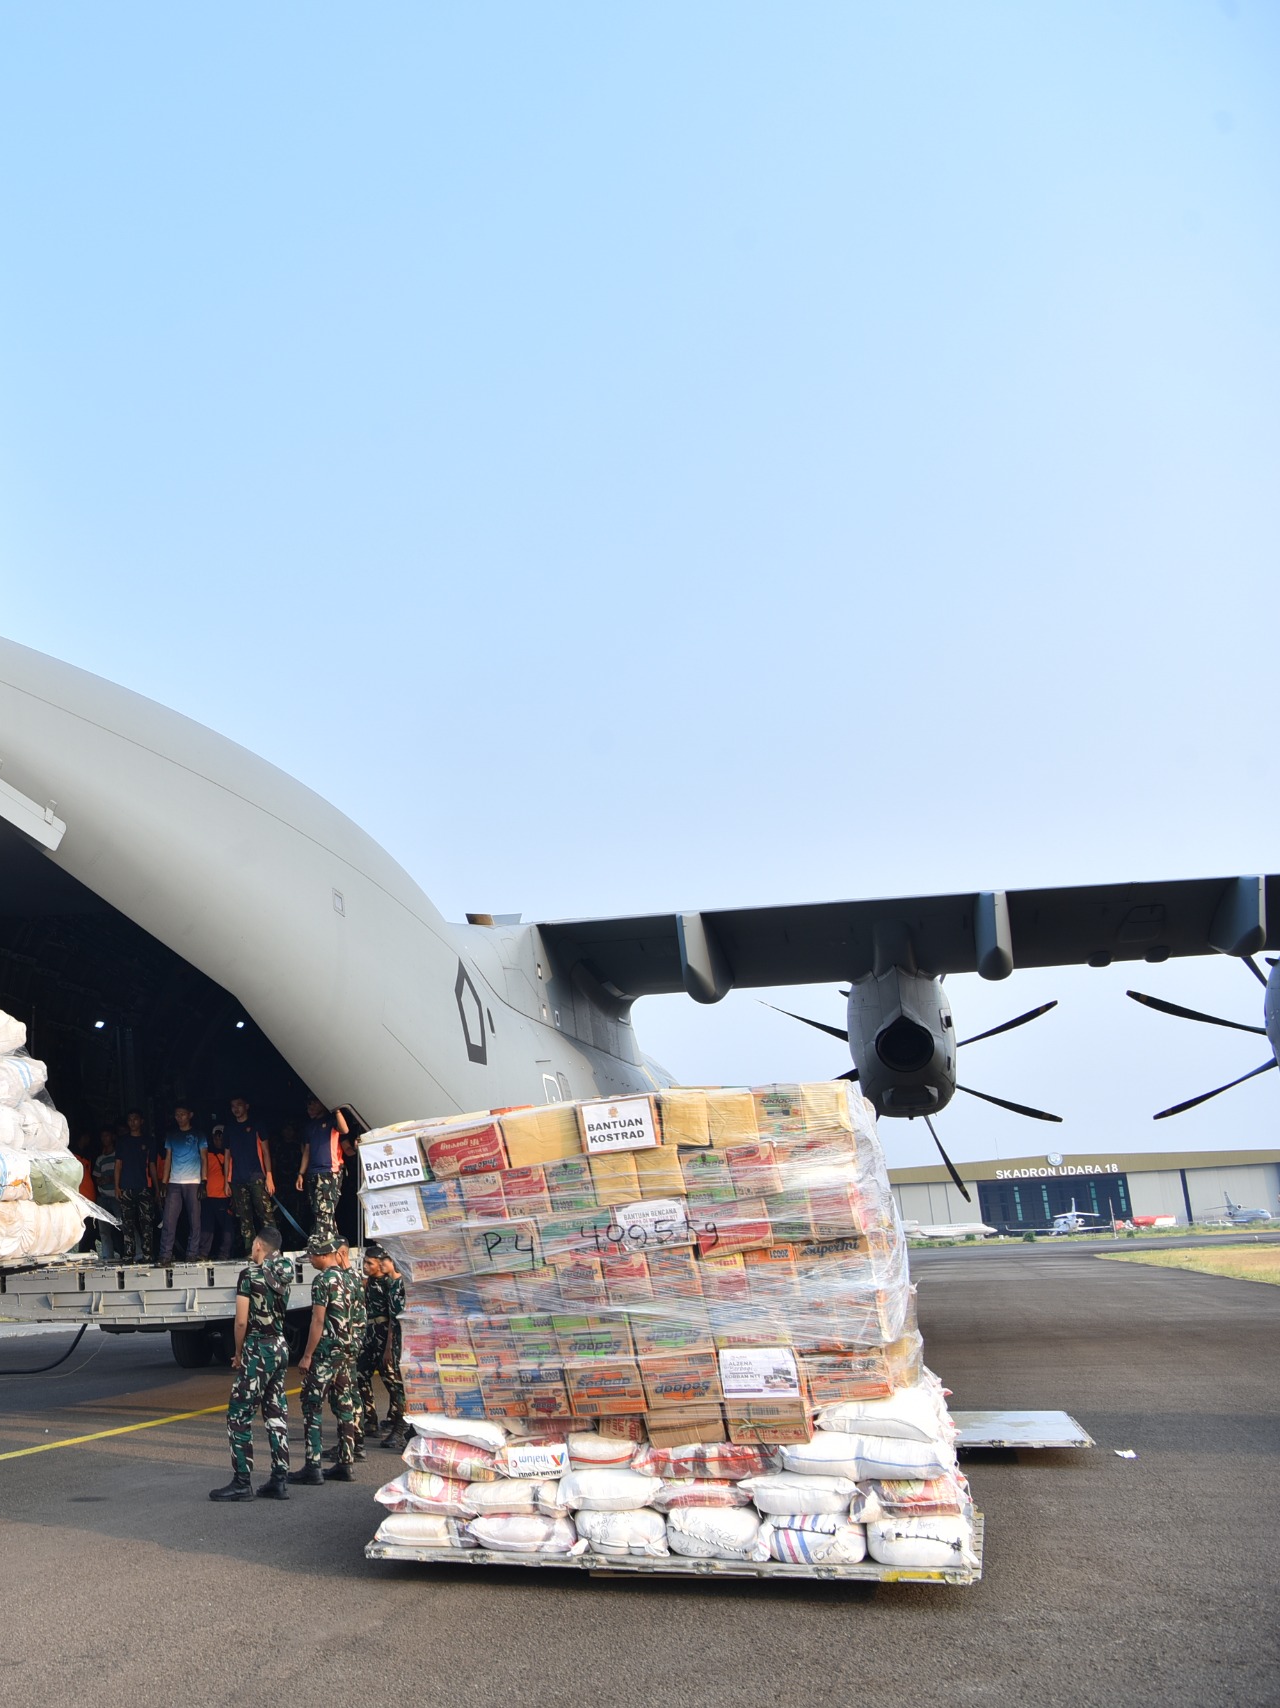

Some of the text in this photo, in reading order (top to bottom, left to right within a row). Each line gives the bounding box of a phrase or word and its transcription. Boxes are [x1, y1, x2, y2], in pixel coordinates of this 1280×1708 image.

[587, 1118, 643, 1132] BANTUAN
[590, 1130, 645, 1144] KOSTRAD
[365, 1155, 418, 1172] BANTUAN
[368, 1167, 420, 1184] KOSTRAD
[995, 1164, 1118, 1180] SKADRON UDARA 18
[651, 1208, 677, 1216] BENCANA
[655, 1381, 711, 1394] Sedaap
